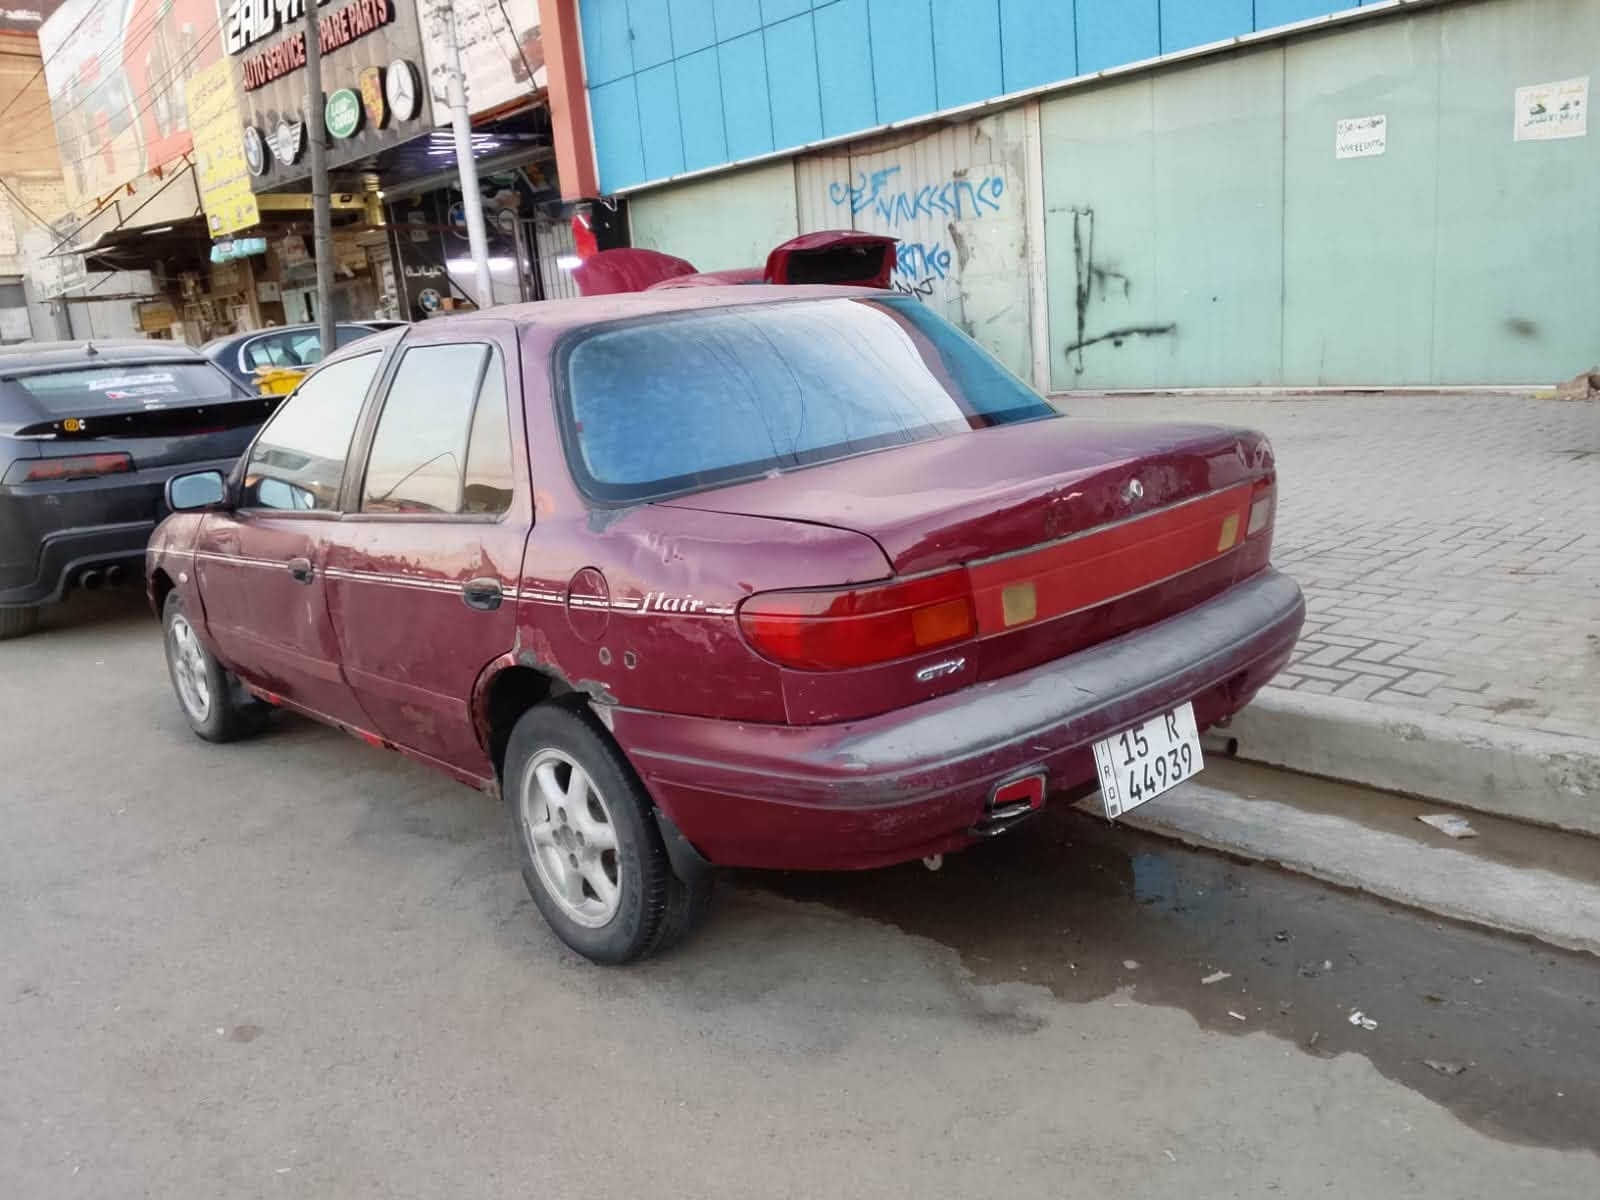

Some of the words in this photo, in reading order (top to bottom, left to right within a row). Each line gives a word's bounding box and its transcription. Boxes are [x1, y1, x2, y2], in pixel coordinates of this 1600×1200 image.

[243, 54, 266, 89] AUTO
[264, 33, 306, 80] SERVICE
[347, 0, 388, 38] PARTS
[1119, 728, 1149, 766] 15
[1165, 712, 1180, 743] R
[1129, 742, 1193, 801] 44939
